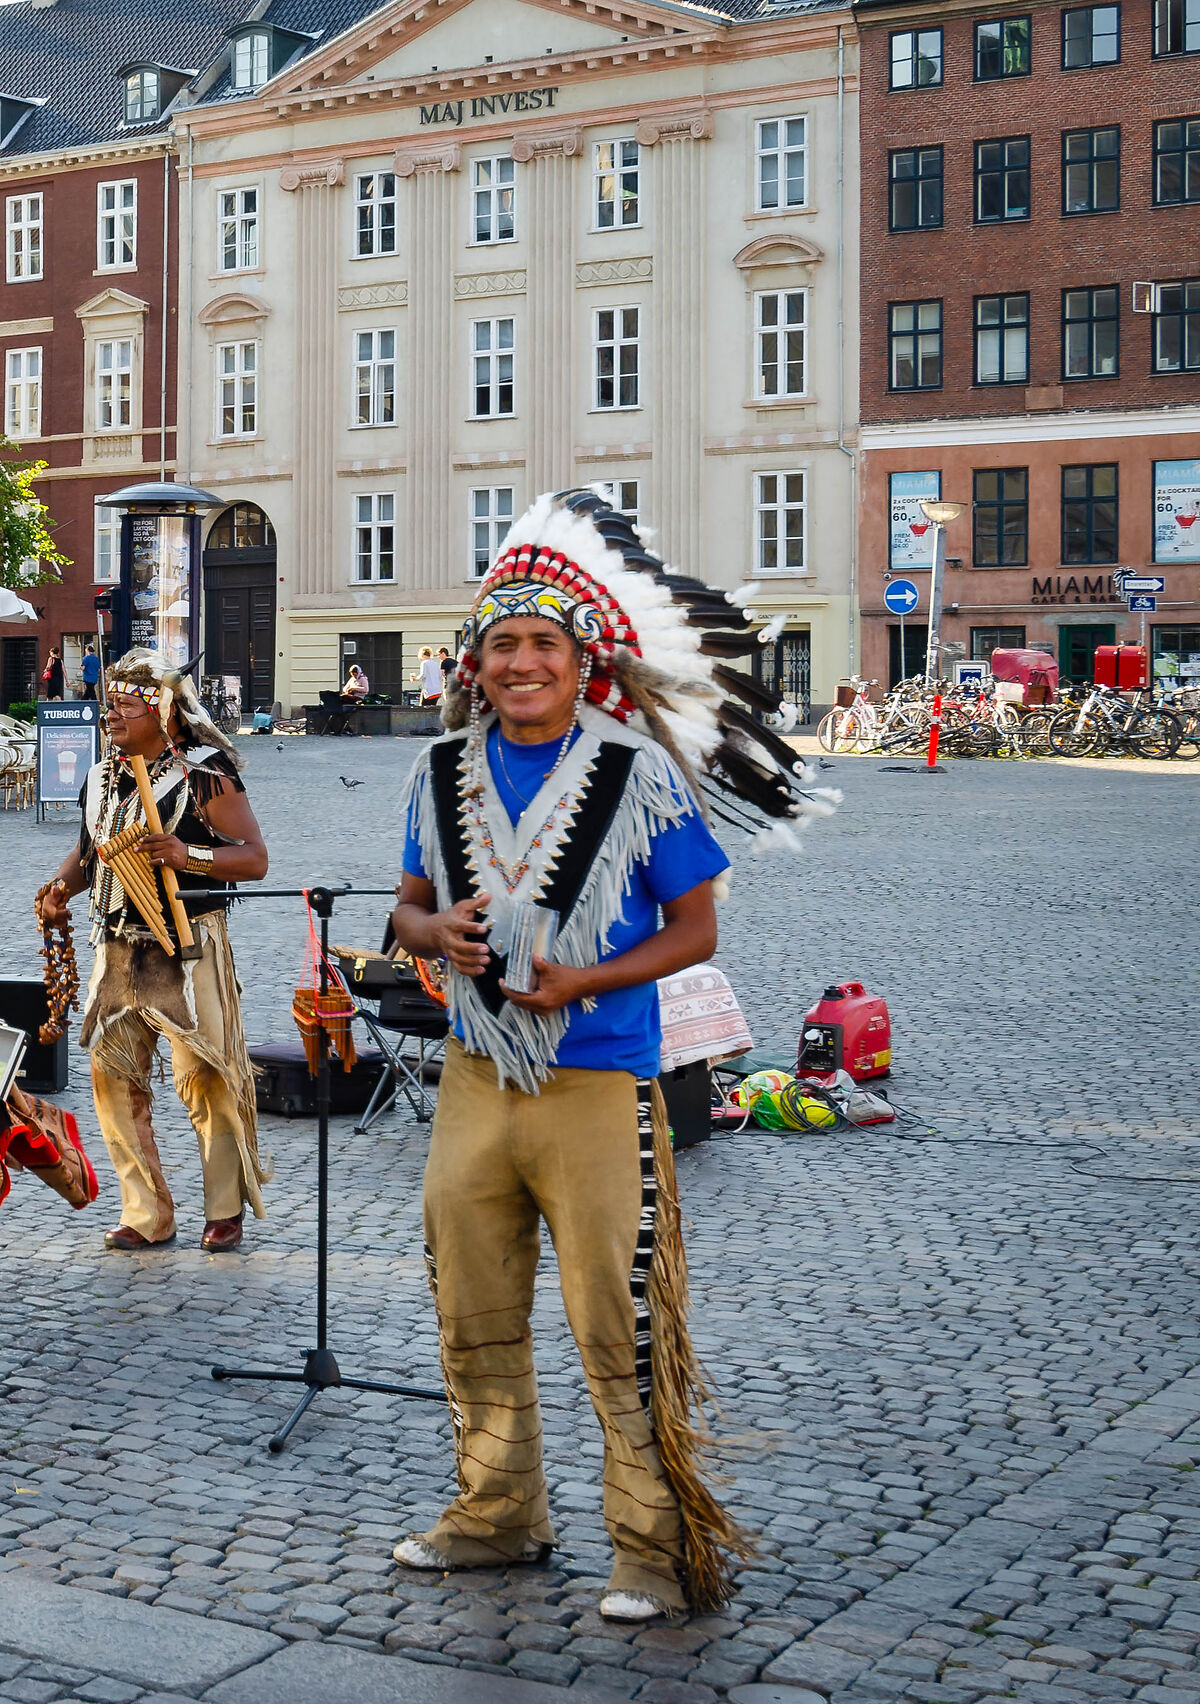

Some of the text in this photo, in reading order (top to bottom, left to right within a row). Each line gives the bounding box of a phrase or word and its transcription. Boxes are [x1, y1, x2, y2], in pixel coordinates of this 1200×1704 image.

[419, 87, 559, 126] MAJ INVEST
[1032, 575, 1112, 595] MIAMI
[43, 710, 81, 719] TUBORG
